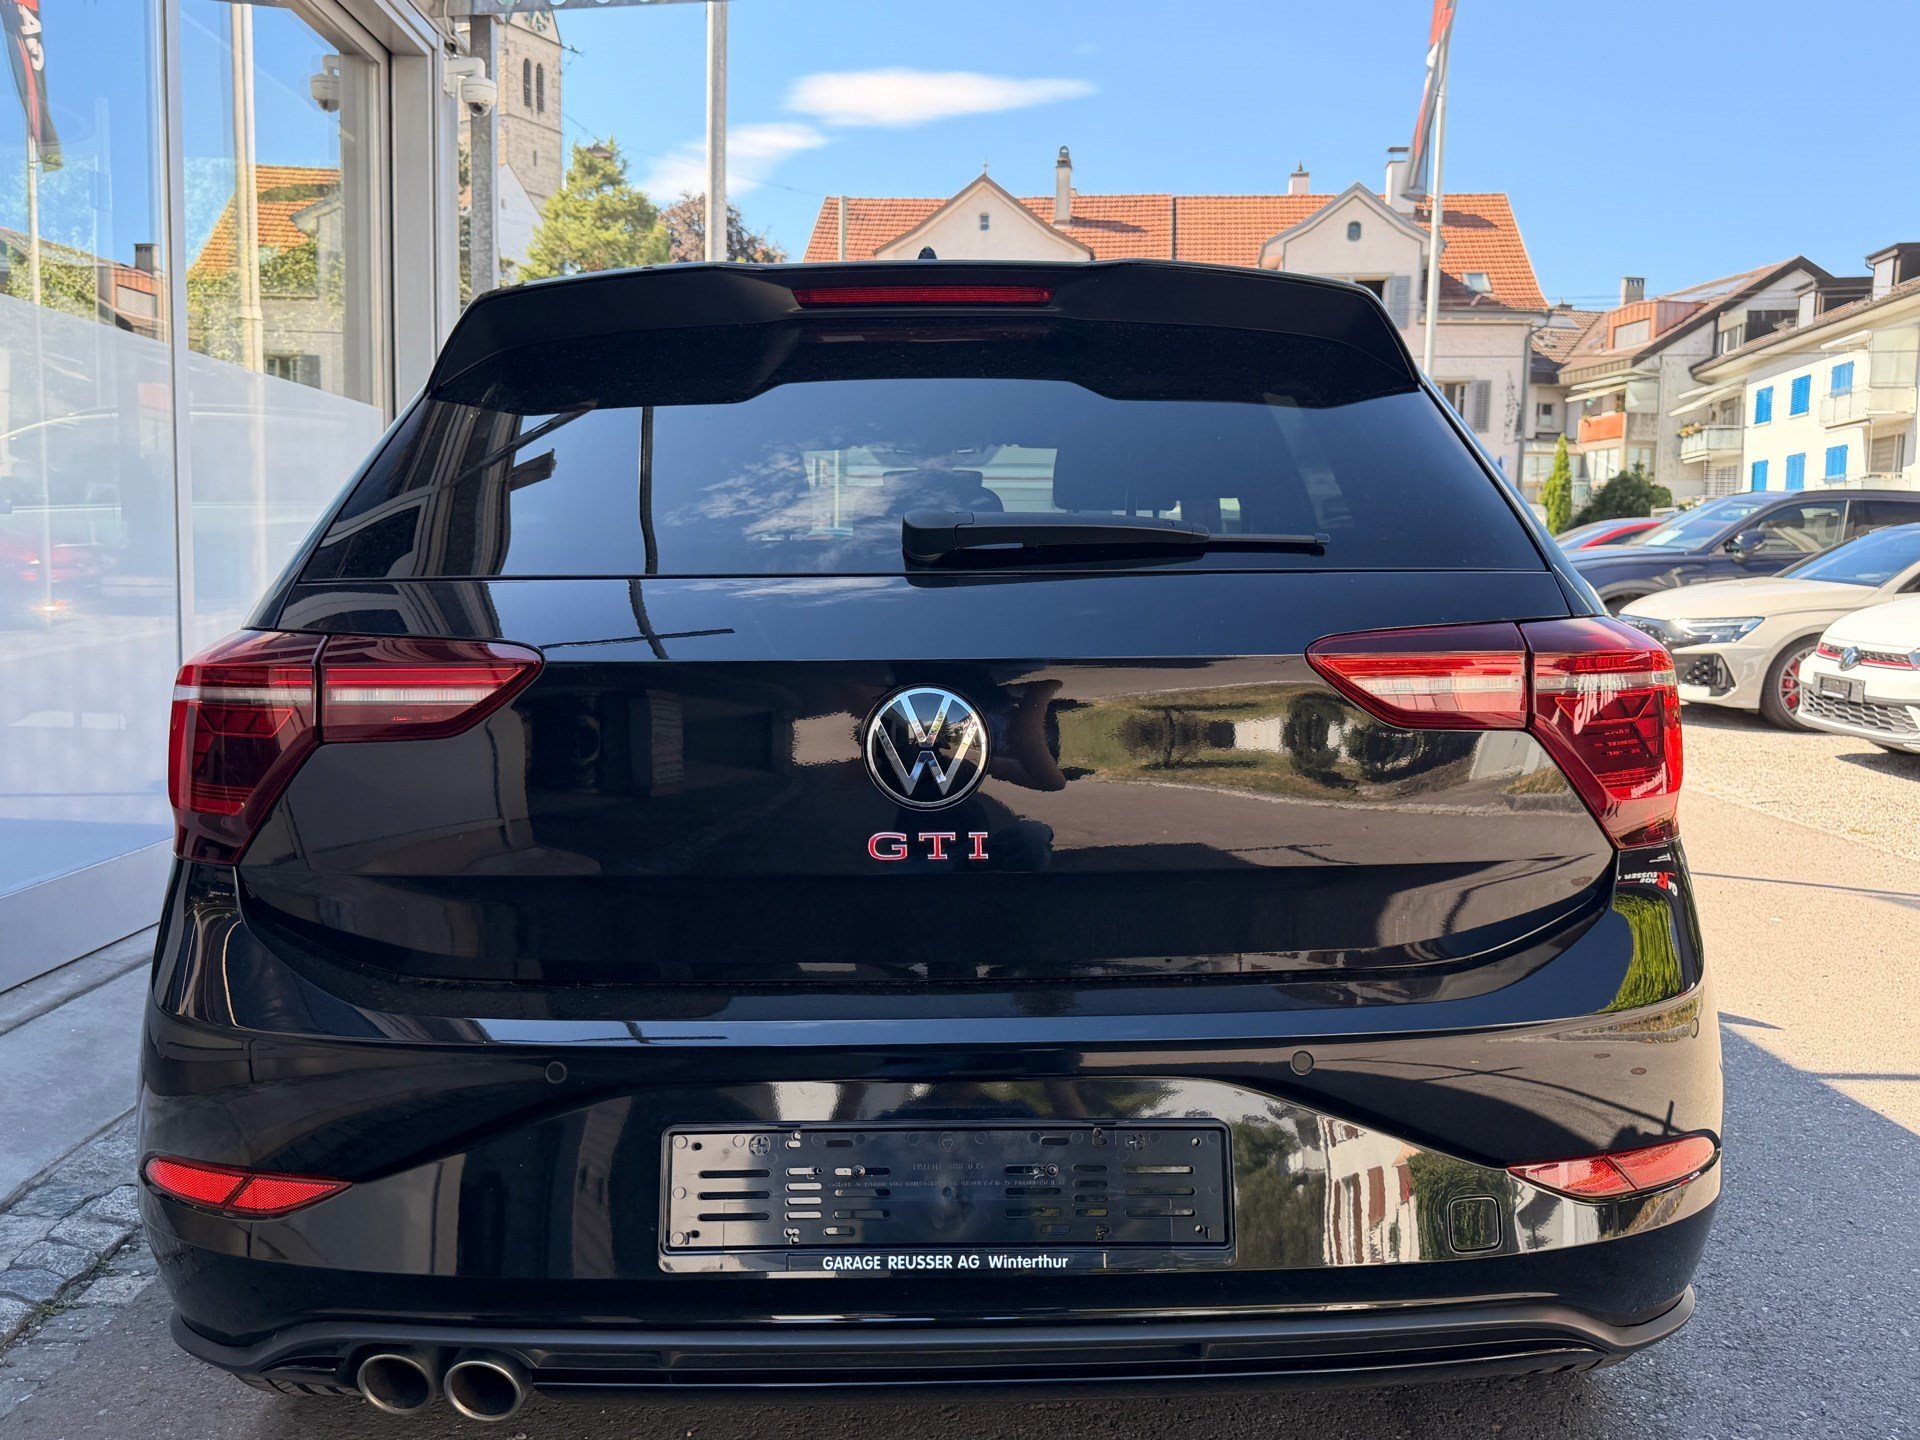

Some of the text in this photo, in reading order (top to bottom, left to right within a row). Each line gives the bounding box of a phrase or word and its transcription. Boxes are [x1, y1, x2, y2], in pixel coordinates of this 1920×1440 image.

[868, 831, 989, 860] GTI
[823, 1254, 1069, 1270] GARAGE REUSSER AG Winterthur
